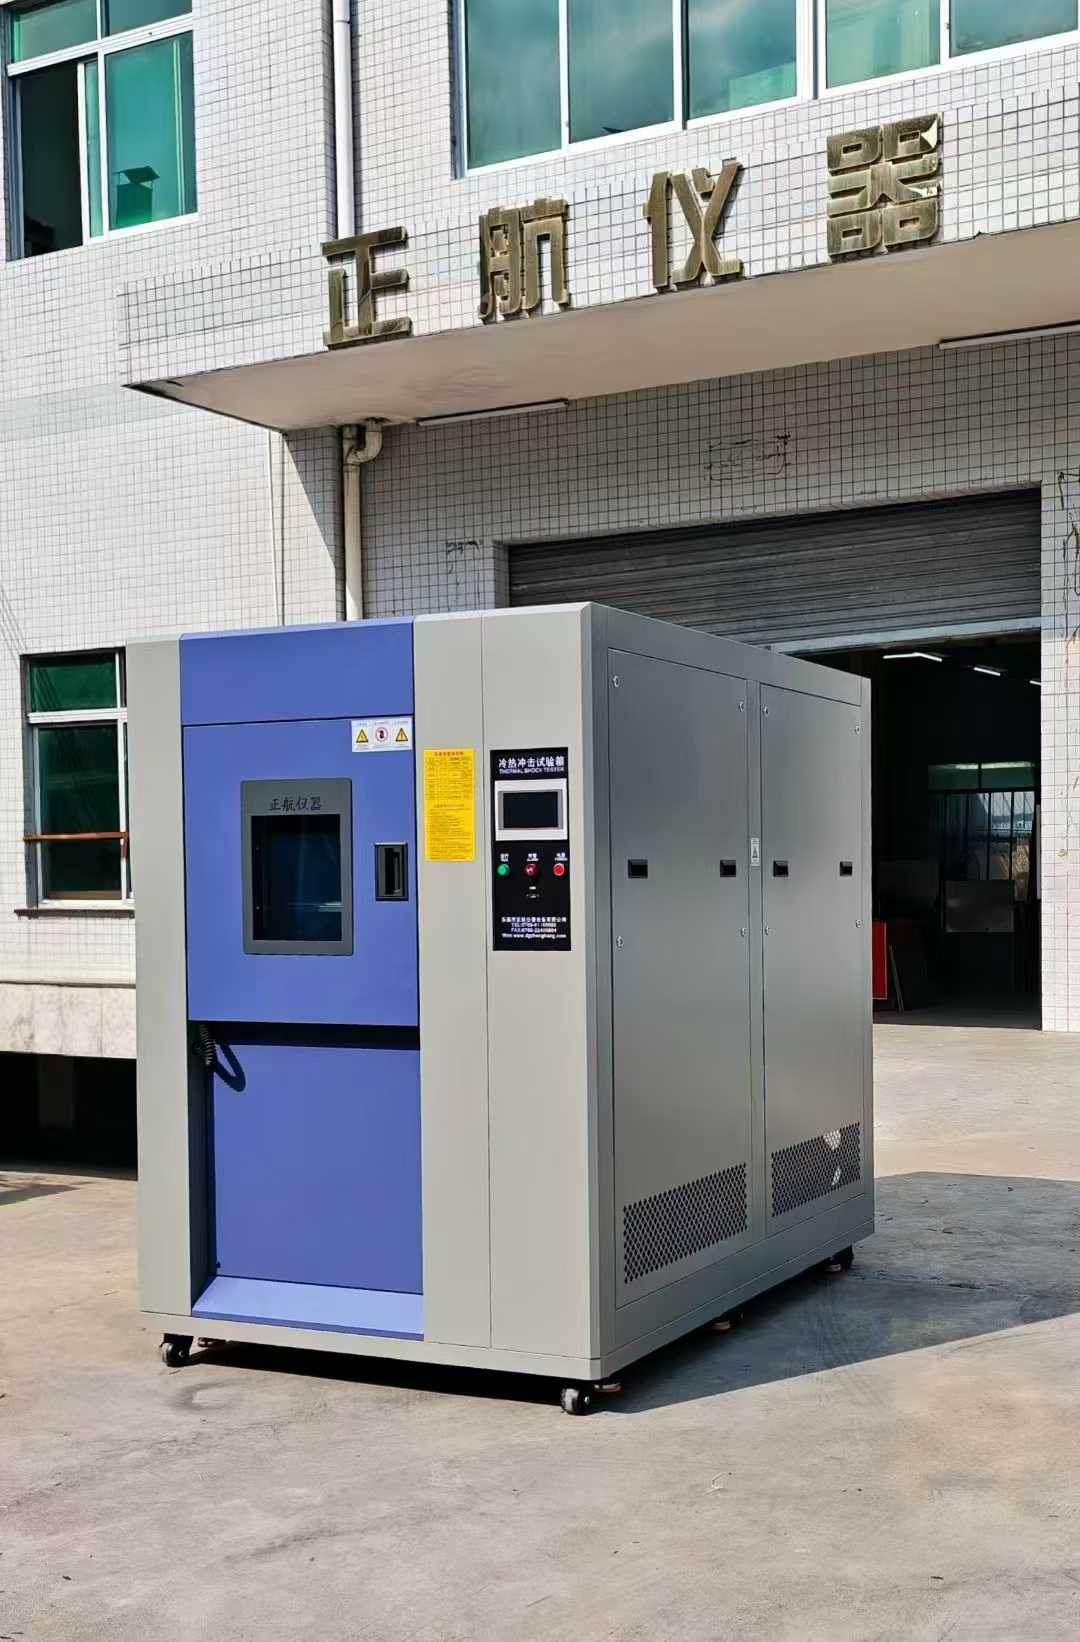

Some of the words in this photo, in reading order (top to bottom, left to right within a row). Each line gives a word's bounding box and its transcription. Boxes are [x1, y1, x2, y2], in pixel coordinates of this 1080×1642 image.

[498, 756, 565, 769] 冷热冲击试验箱
